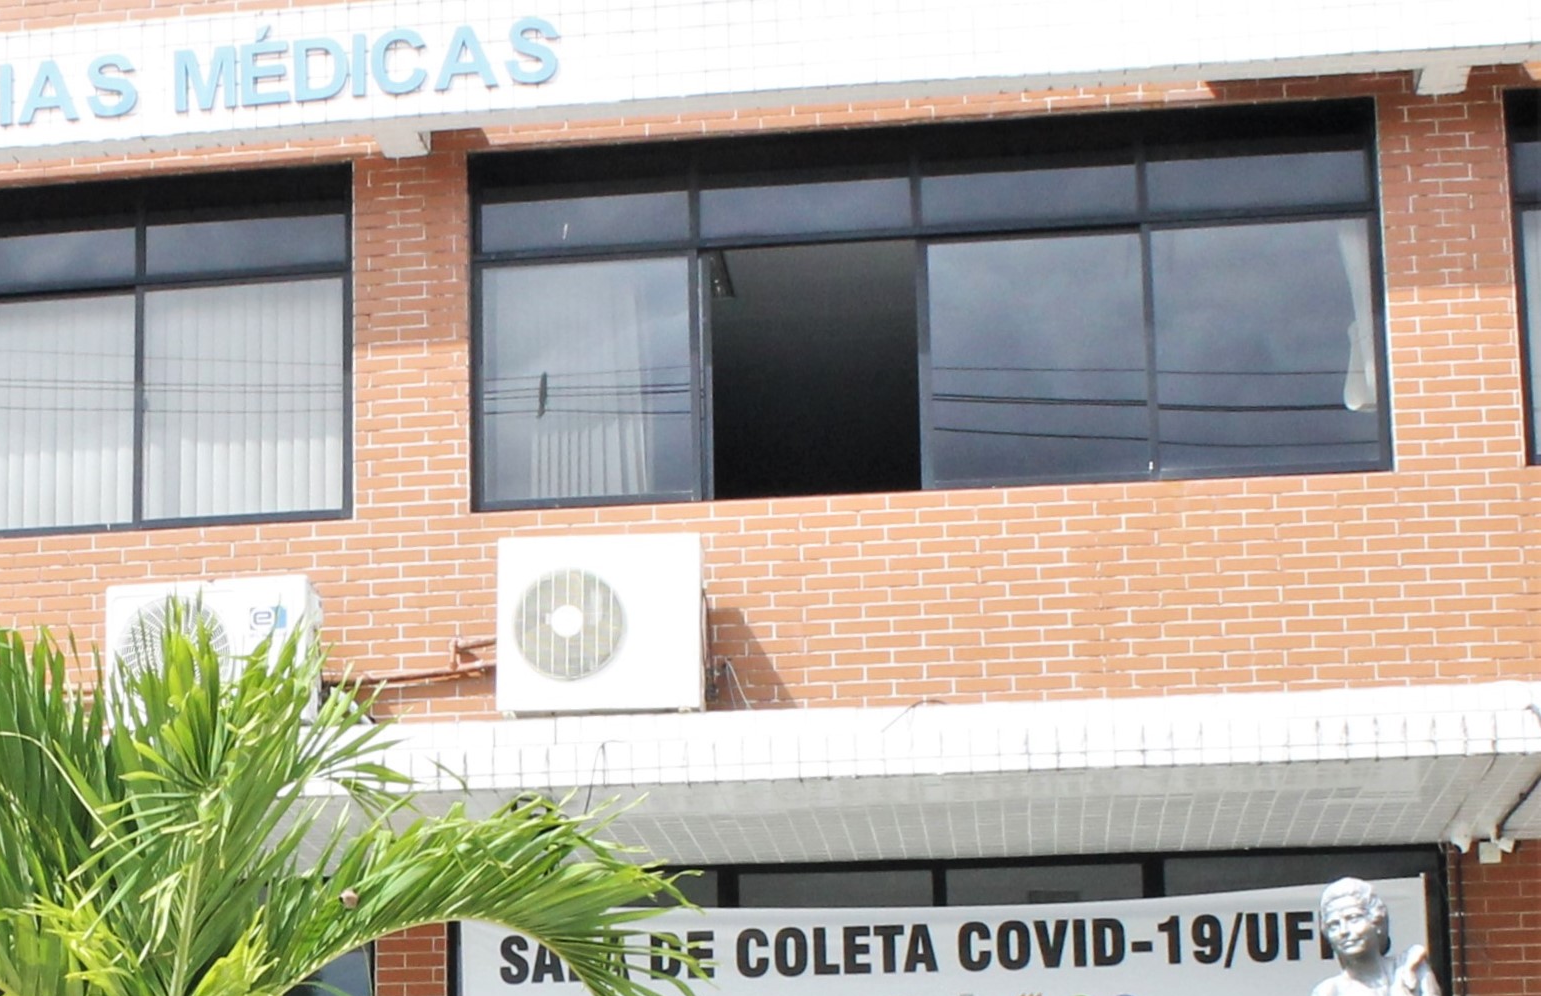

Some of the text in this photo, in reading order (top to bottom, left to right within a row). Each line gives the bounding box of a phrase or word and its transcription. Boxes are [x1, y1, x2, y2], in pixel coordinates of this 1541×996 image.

[174, 16, 559, 113] MÉDICAS
[500, 911, 1391, 984] SA DE COLETA COVID-19/UF
